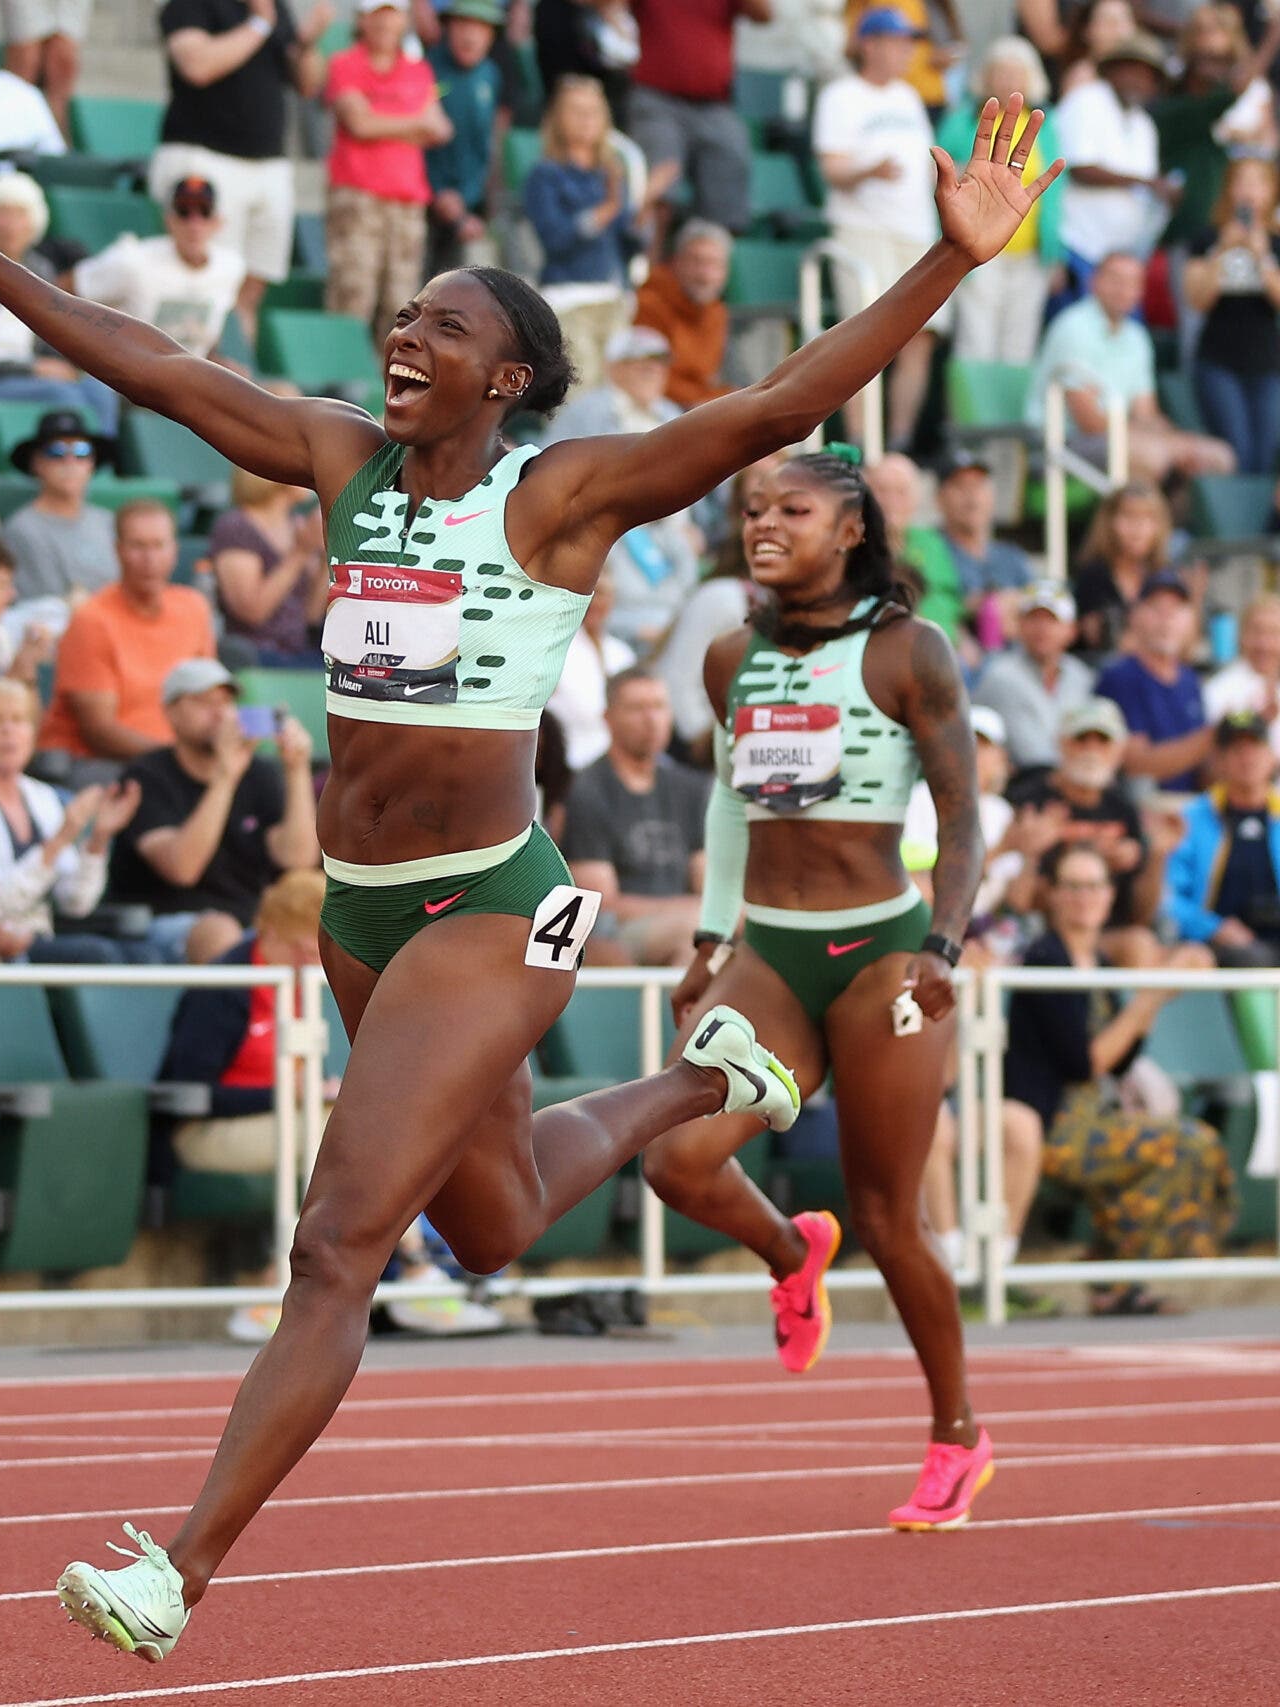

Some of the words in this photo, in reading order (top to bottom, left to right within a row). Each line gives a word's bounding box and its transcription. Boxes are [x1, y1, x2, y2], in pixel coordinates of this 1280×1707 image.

[365, 577, 419, 592] TOYOTA
[364, 620, 390, 646] ALI
[749, 747, 814, 767] MARSHALL
[533, 895, 584, 962] 4
